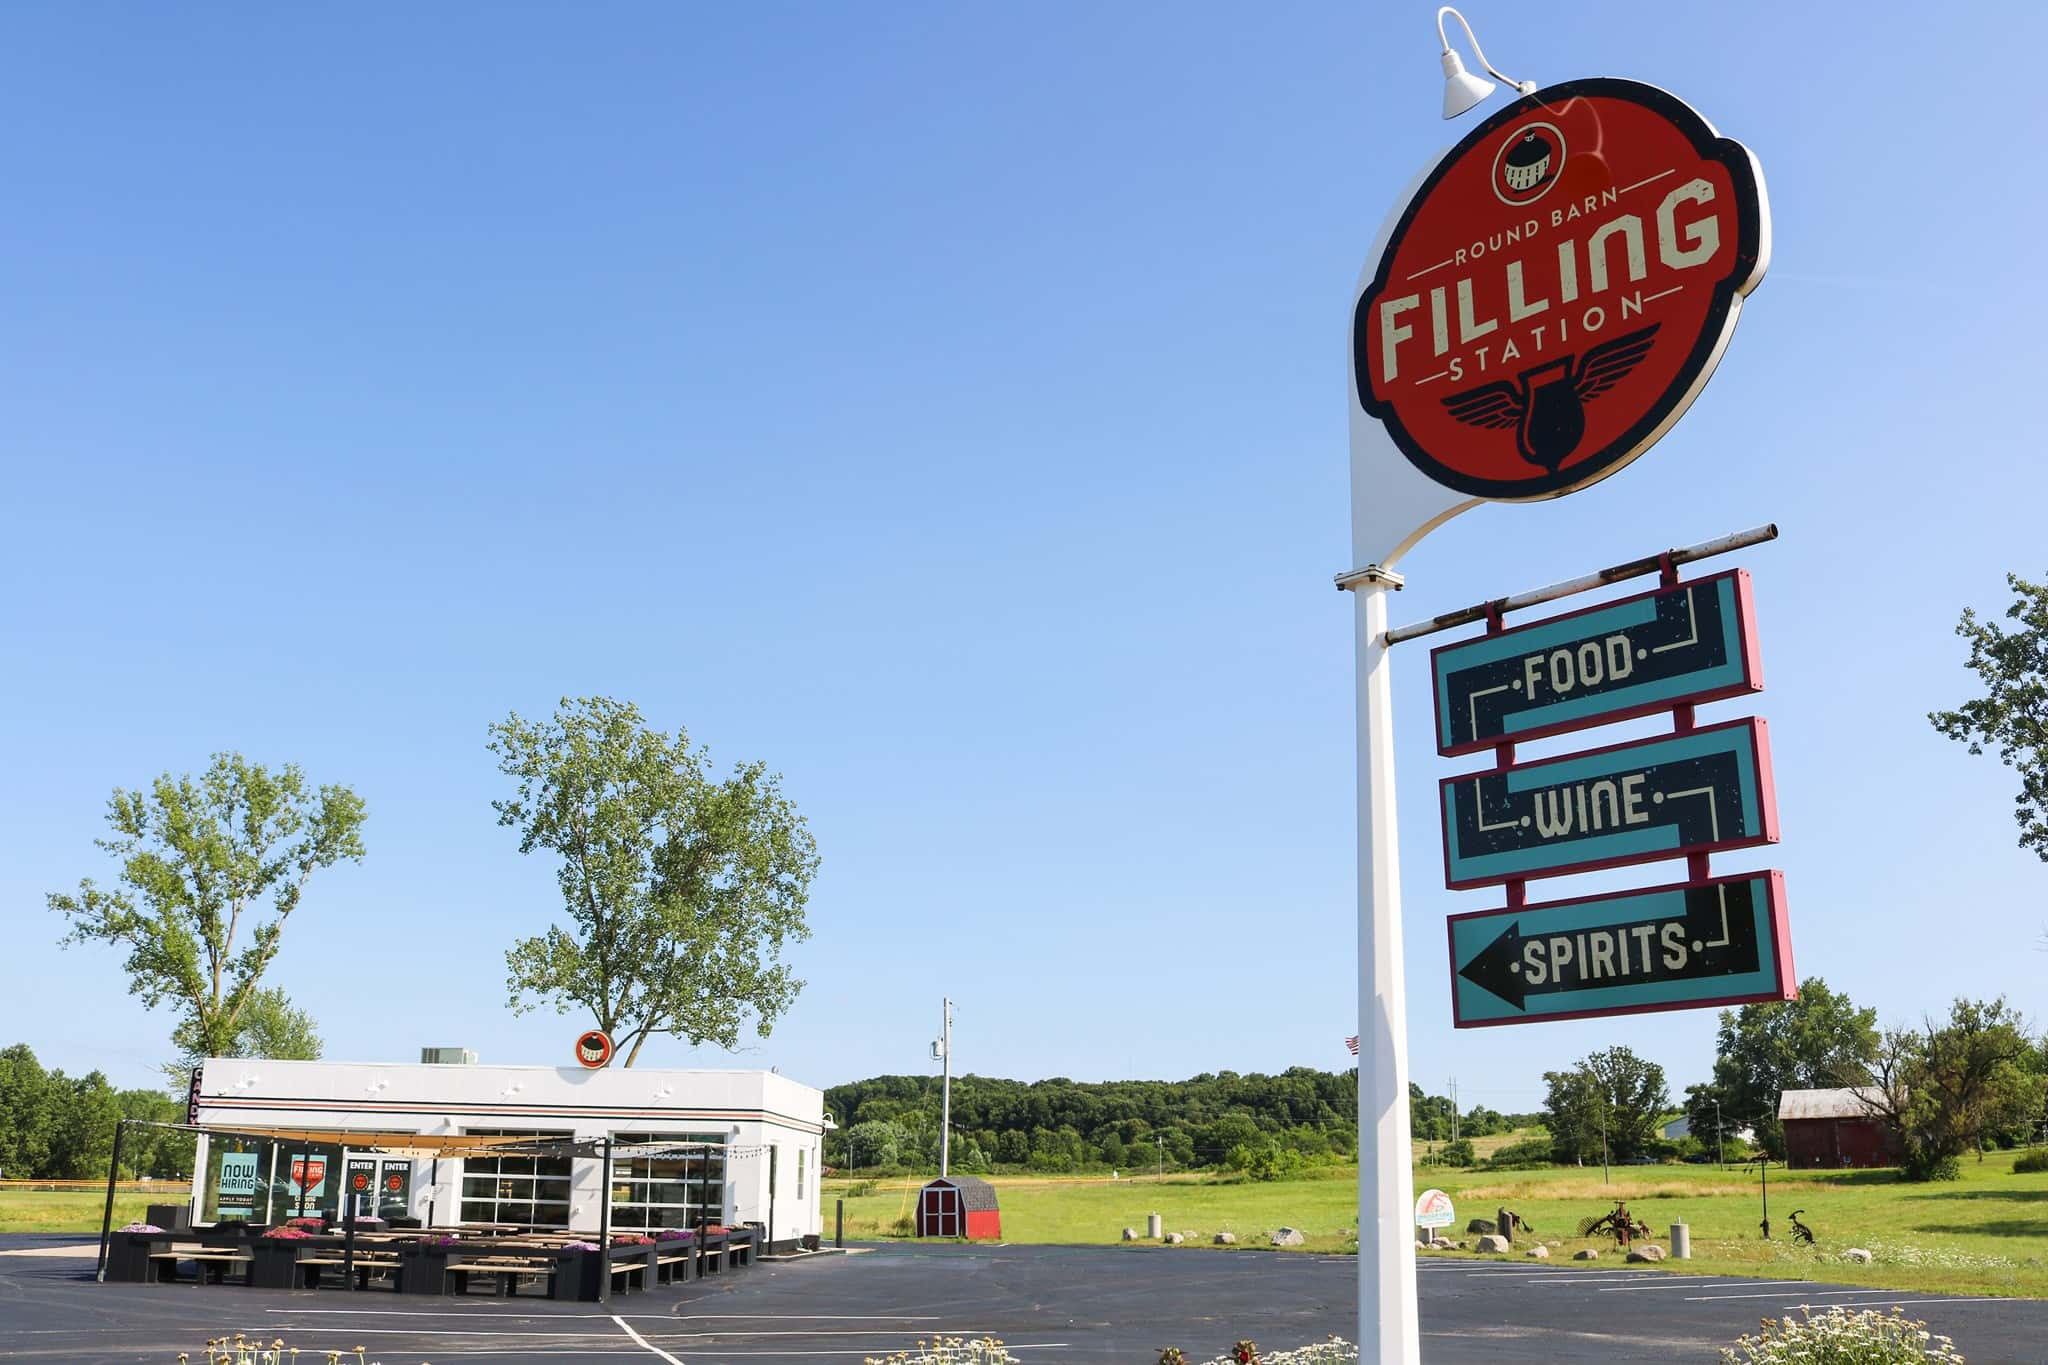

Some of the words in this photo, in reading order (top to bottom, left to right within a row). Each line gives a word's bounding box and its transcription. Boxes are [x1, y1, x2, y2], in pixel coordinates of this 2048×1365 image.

[1455, 219, 1539, 266] ROUND
[1551, 186, 1617, 227] BARN
[1380, 177, 1721, 384] FILLING
[1449, 290, 1643, 381] STATION
[1524, 633, 1633, 701] FOOD
[1534, 773, 1649, 839] WINE
[1523, 922, 1688, 986] SPIRITS
[190, 1068, 203, 1127] CANDY
[221, 1178, 254, 1190] HIRING
[224, 1164, 254, 1178] NOW
[350, 1161, 374, 1170] ENTER
[384, 1162, 409, 1171] ENTER
[294, 1202, 315, 1210] SON
